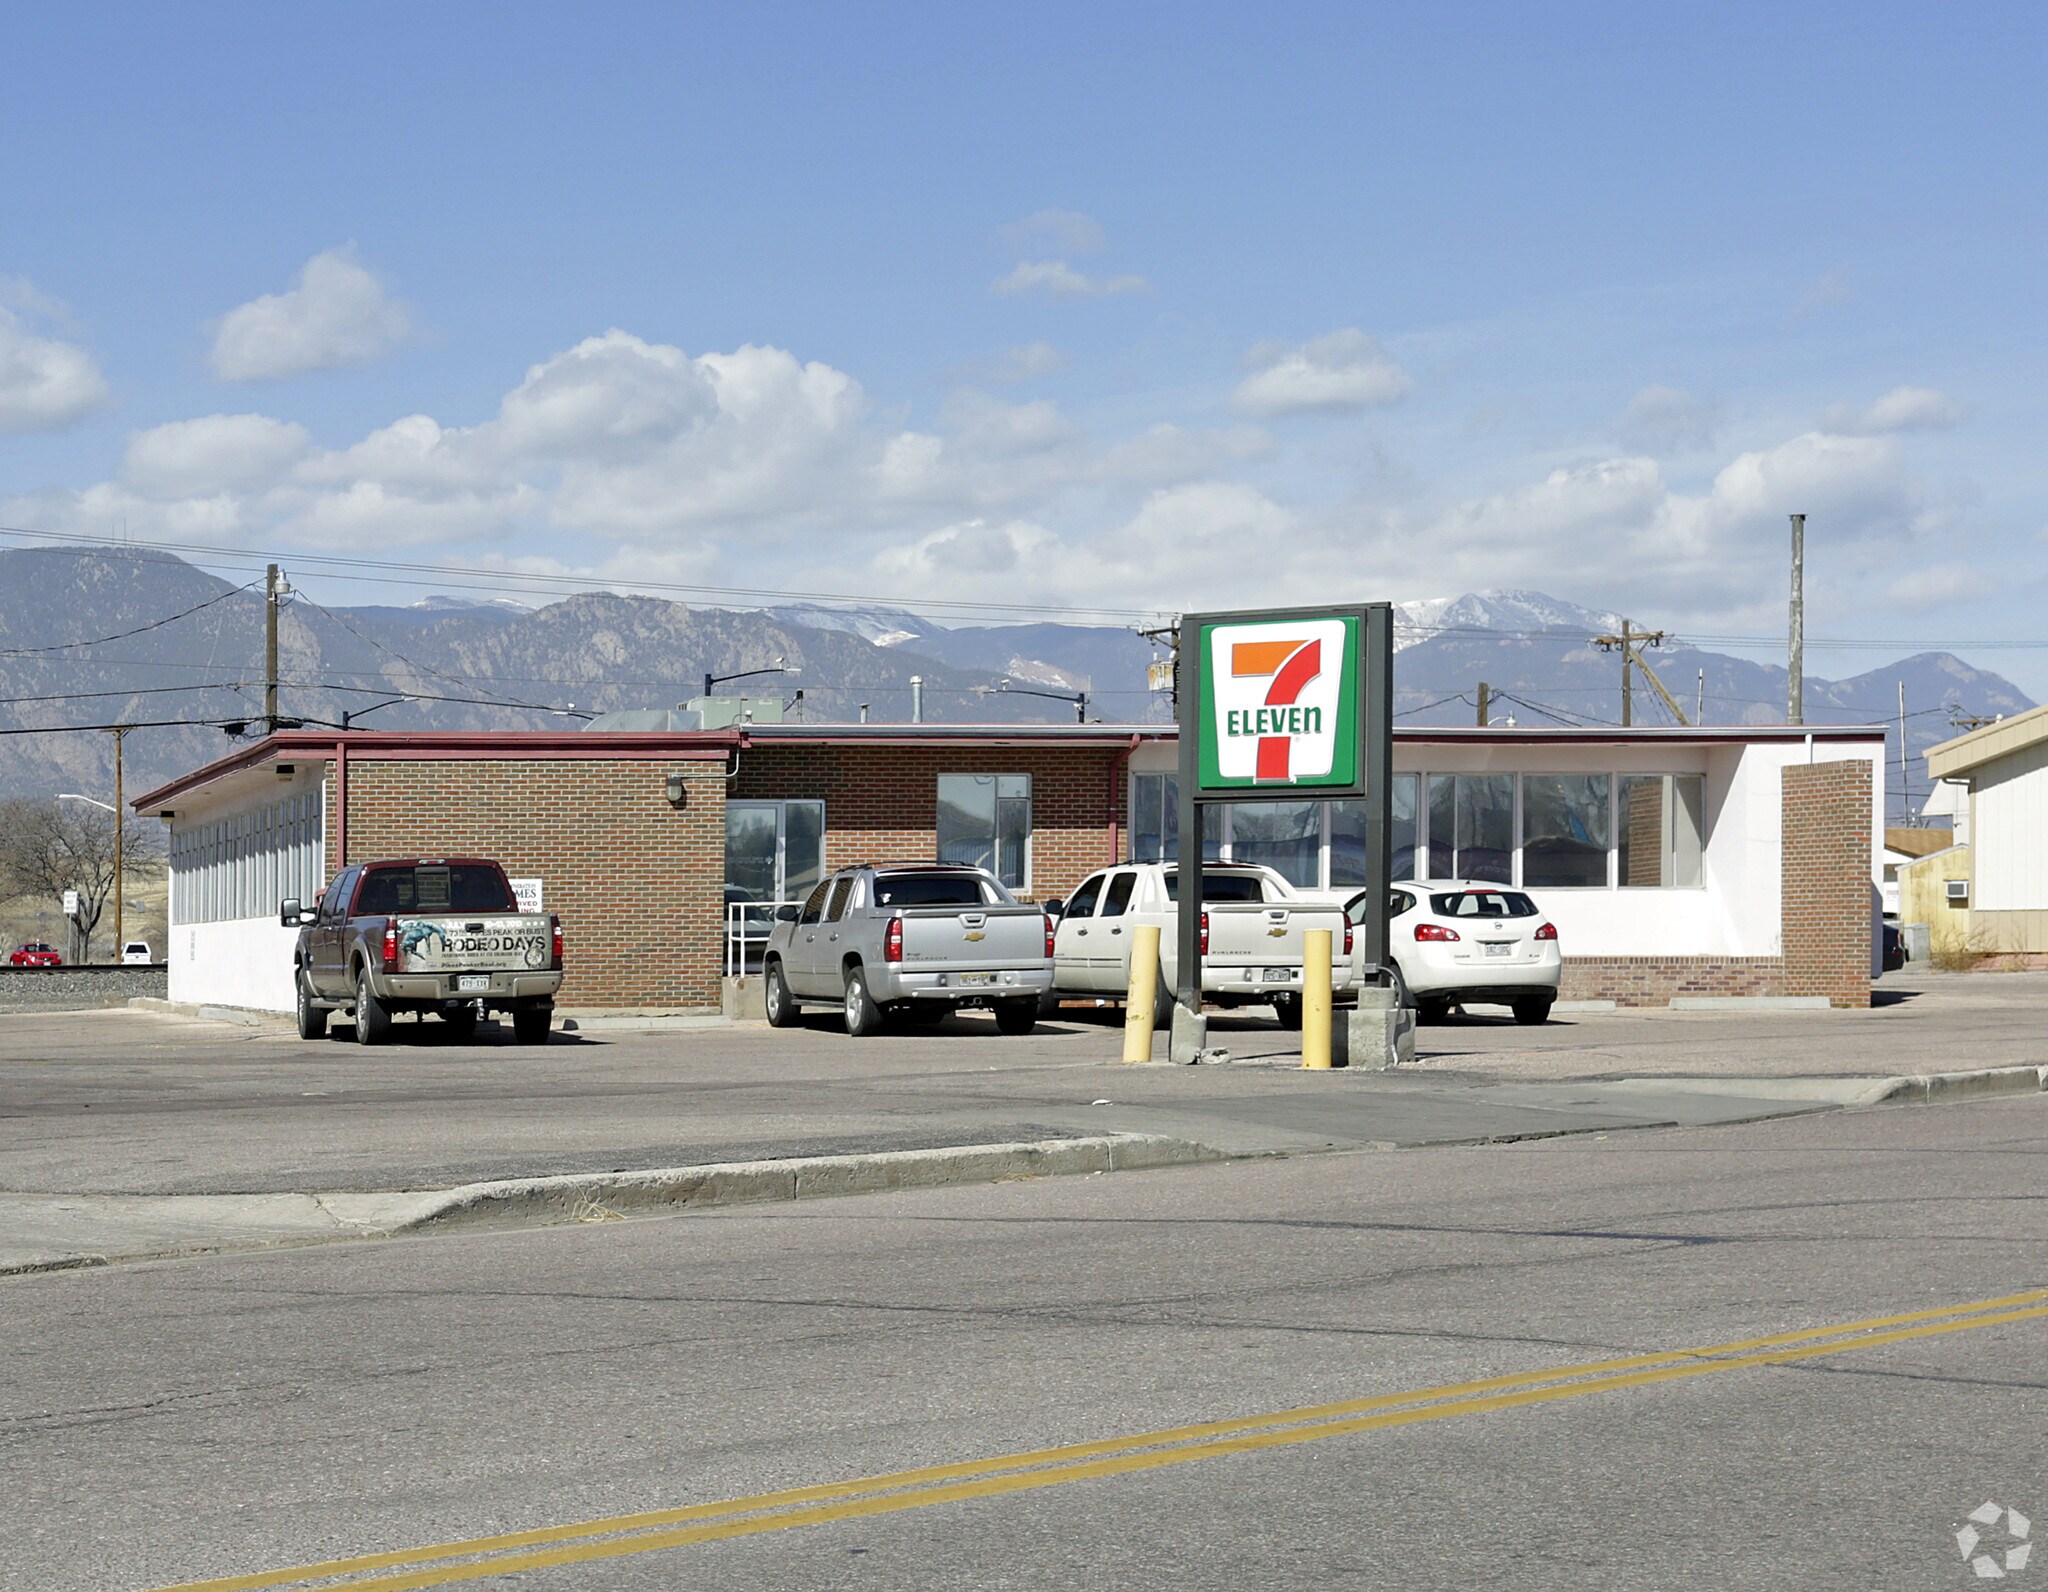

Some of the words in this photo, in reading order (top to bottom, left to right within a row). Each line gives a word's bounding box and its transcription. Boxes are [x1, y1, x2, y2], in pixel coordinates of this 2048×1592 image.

[1231, 638, 1321, 779] 7
[516, 889, 537, 899] MES
[493, 928, 513, 936] PEAK
[526, 927, 546, 935] BUST
[441, 937, 500, 952] RODEO
[503, 936, 546, 951] DAYS
